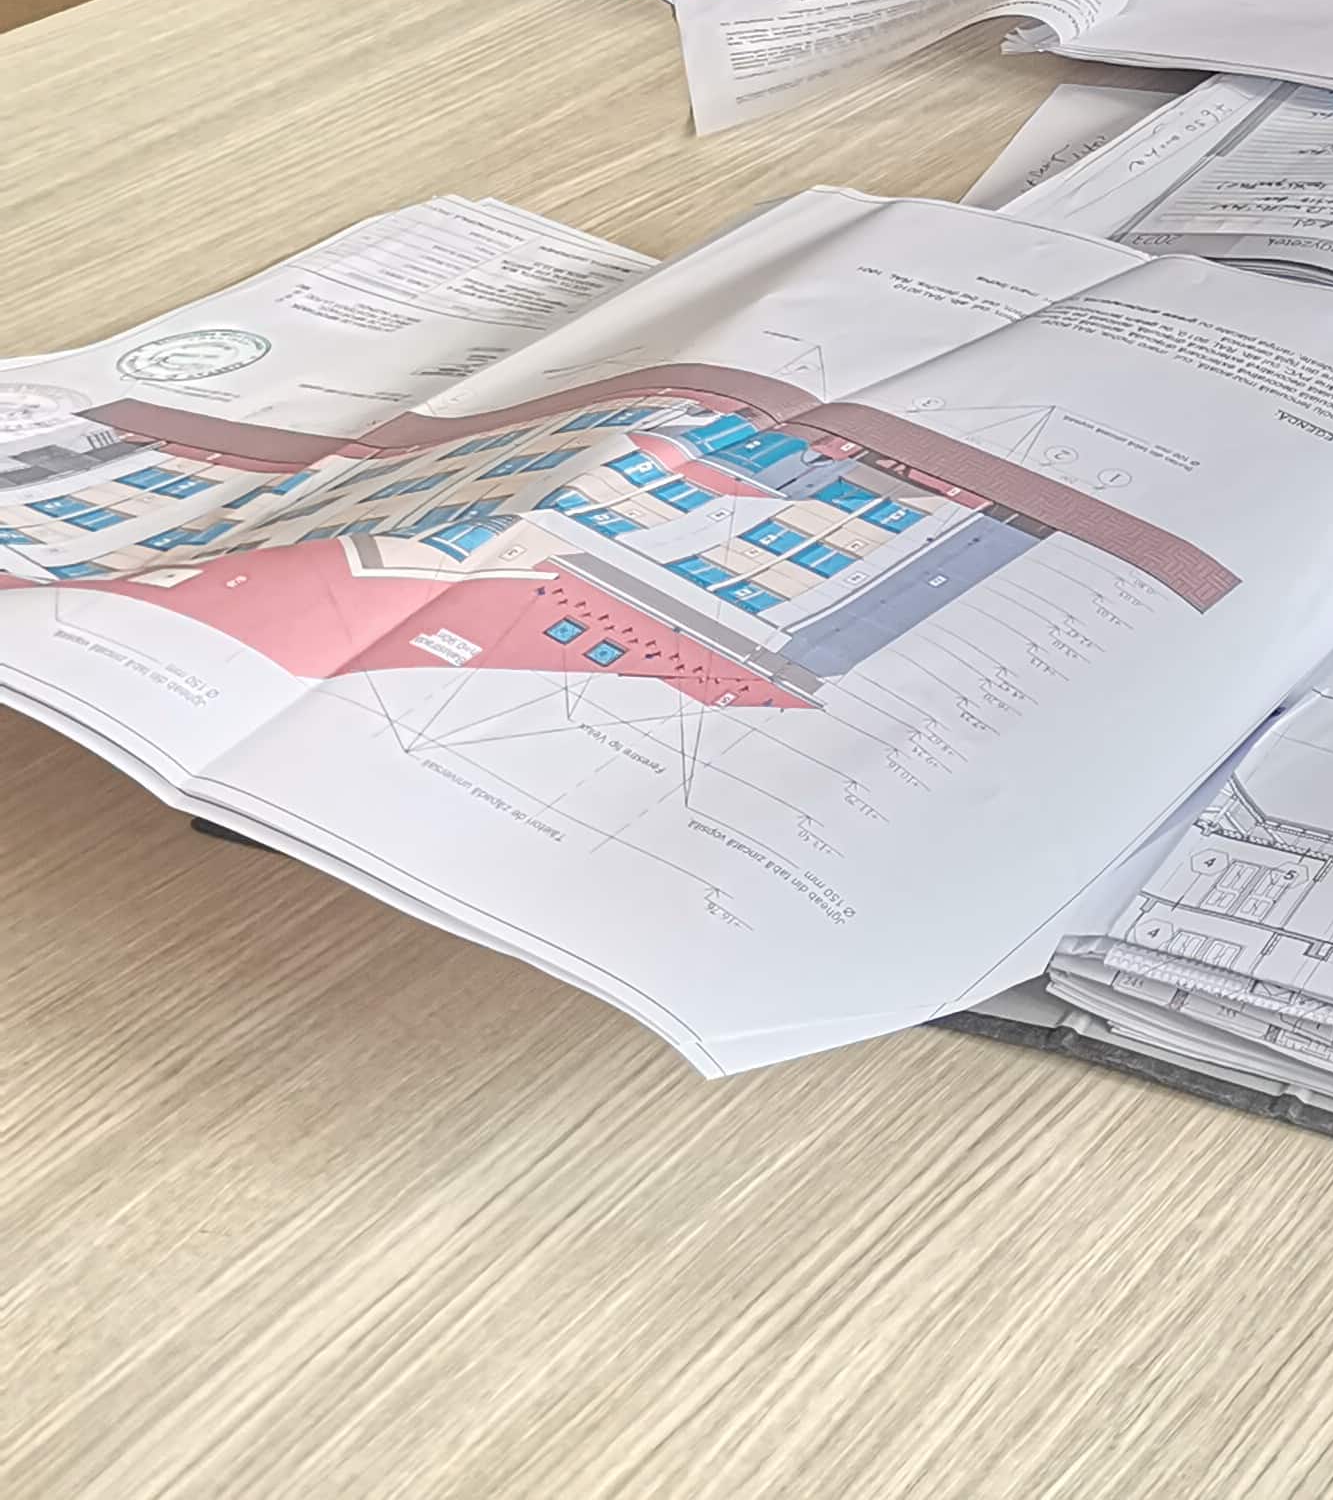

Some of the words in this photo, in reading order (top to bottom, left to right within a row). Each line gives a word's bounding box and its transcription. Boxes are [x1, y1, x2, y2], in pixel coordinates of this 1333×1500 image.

[726, 839, 766, 862] zincată
[1203, 856, 1216, 869] 4
[804, 871, 826, 889] mm
[1283, 868, 1297, 881] 5
[791, 878, 809, 892] din
[823, 888, 843, 907] 150
[808, 891, 845, 924] Jgheab
[1147, 926, 1160, 938] 4
